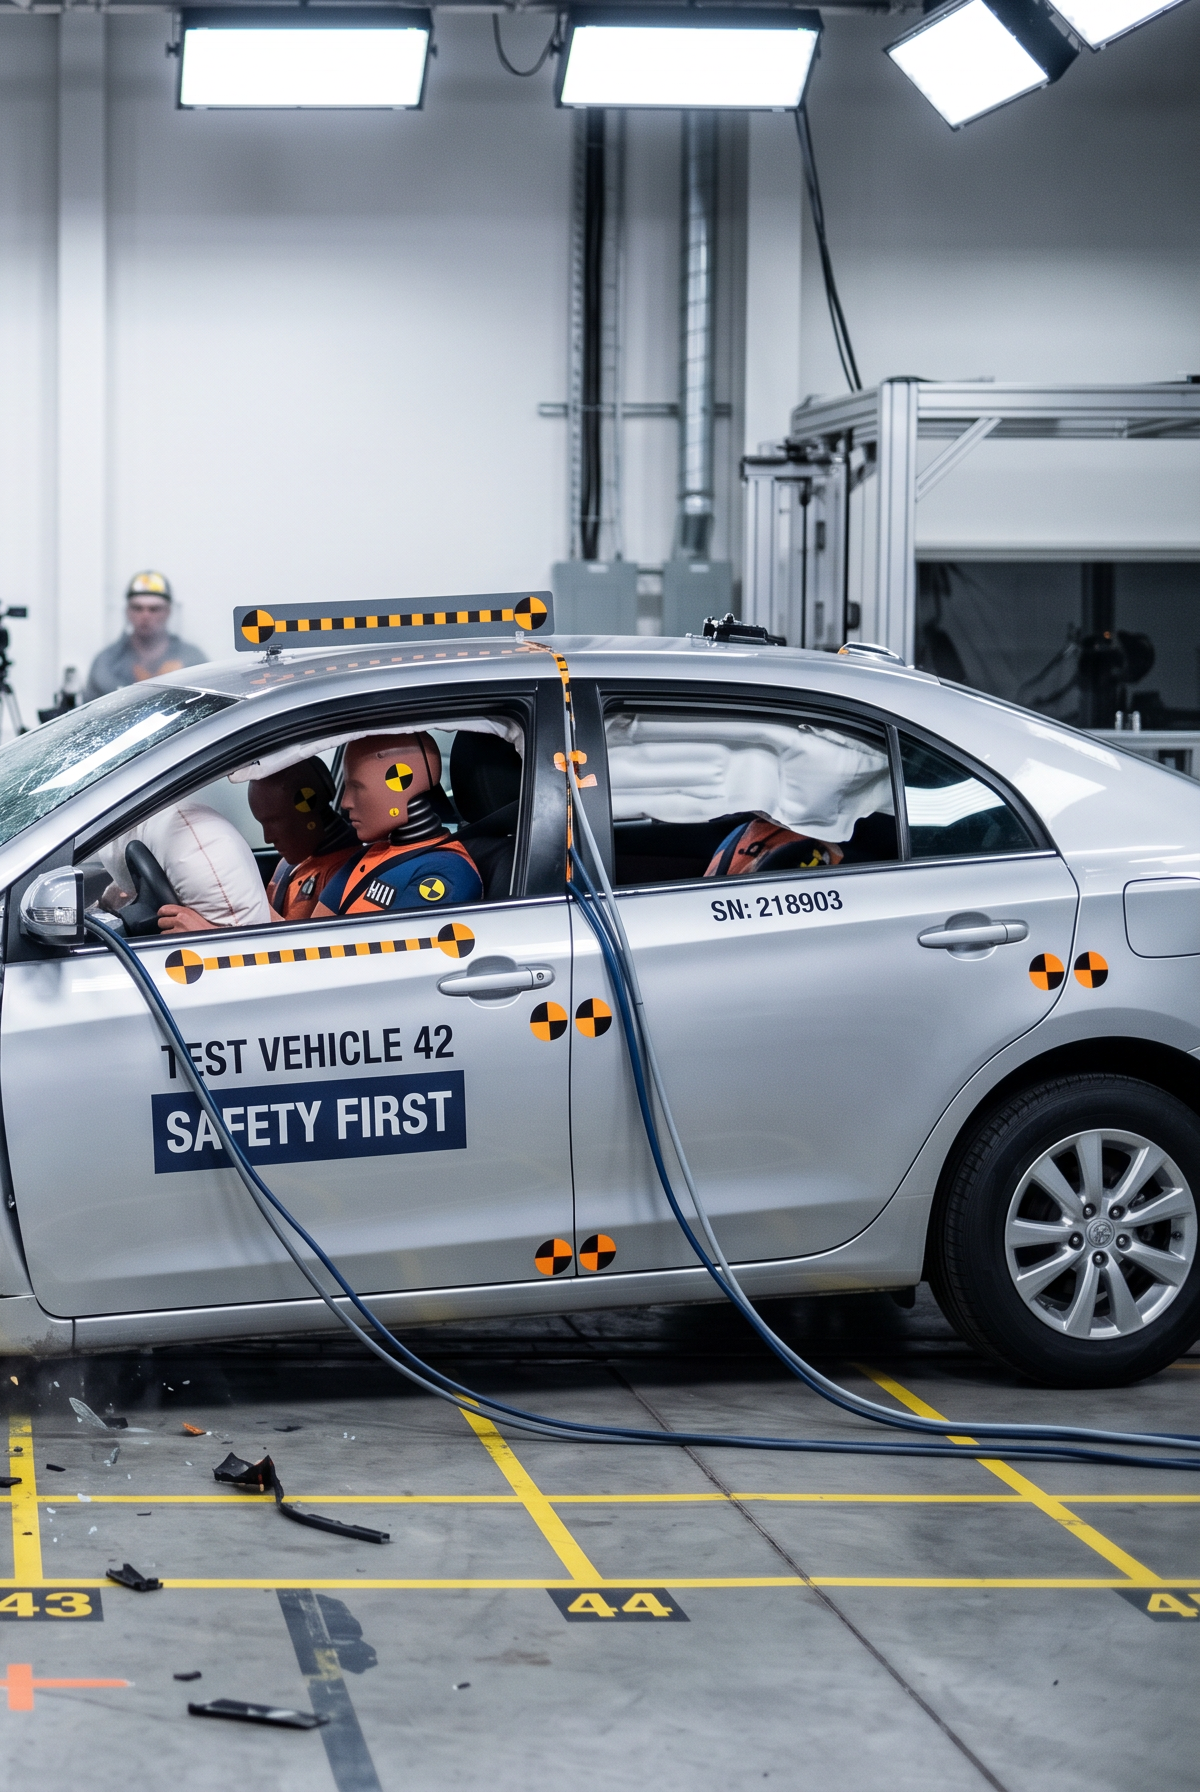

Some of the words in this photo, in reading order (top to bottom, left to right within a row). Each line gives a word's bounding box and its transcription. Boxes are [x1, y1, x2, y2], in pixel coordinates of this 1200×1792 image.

[711, 899, 752, 922] SN:
[756, 890, 843, 918] 218903
[258, 1027, 403, 1072] VEHICLE
[413, 1024, 455, 1060] 42
[166, 1100, 322, 1154] SAFETY
[336, 1090, 453, 1141] FIRST
[567, 1592, 674, 1617] 44
